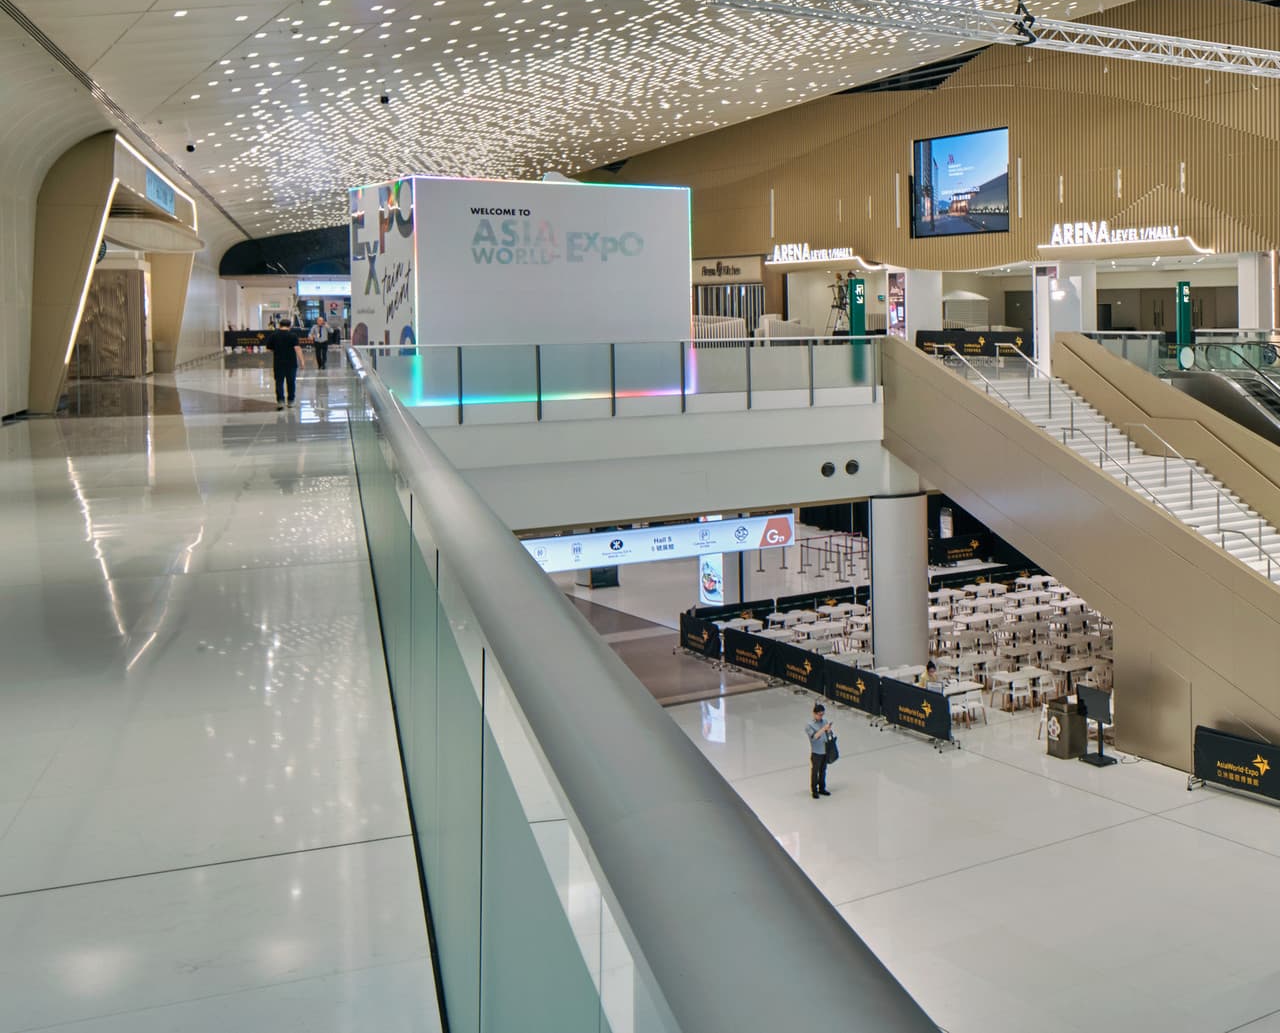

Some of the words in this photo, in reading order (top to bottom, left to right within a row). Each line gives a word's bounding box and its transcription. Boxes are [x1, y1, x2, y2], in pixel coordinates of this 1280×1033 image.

[471, 208, 516, 216] WELCOME
[472, 219, 558, 247] ASIA
[1051, 221, 1110, 245] ARENA
[1111, 229, 1138, 241] LEVEL
[774, 243, 809, 262] ARENA
[1217, 761, 1259, 776] AsiaWorld-Expo
